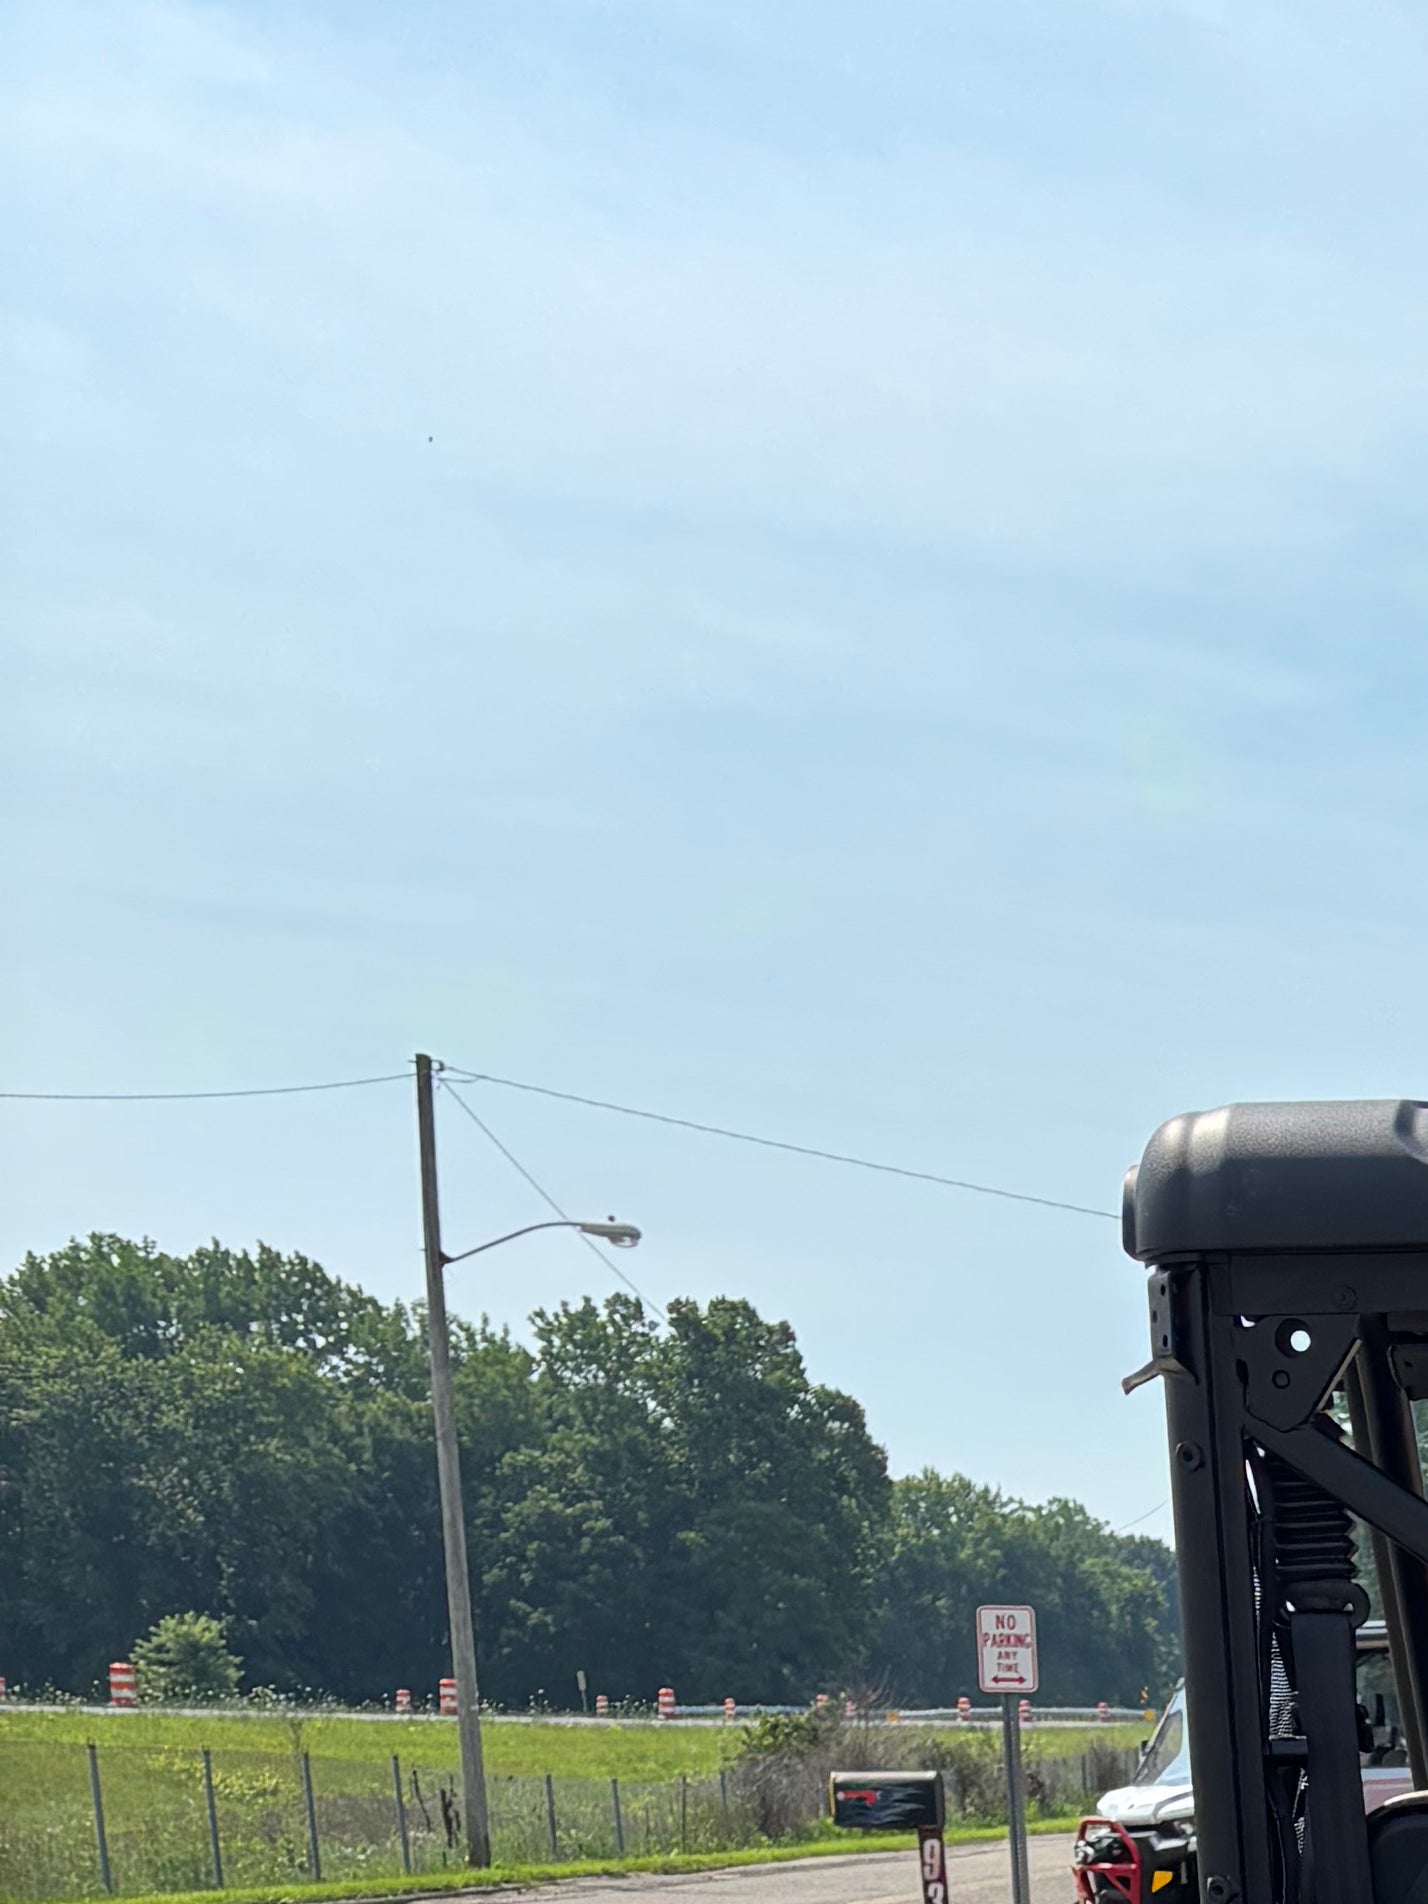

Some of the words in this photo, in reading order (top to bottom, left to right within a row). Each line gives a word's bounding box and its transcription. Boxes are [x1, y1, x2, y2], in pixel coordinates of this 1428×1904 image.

[995, 1614, 1017, 1631] NO
[982, 1632, 1032, 1649] PARKING
[997, 1650, 1018, 1660] ANY
[996, 1662, 1020, 1673] TIME
